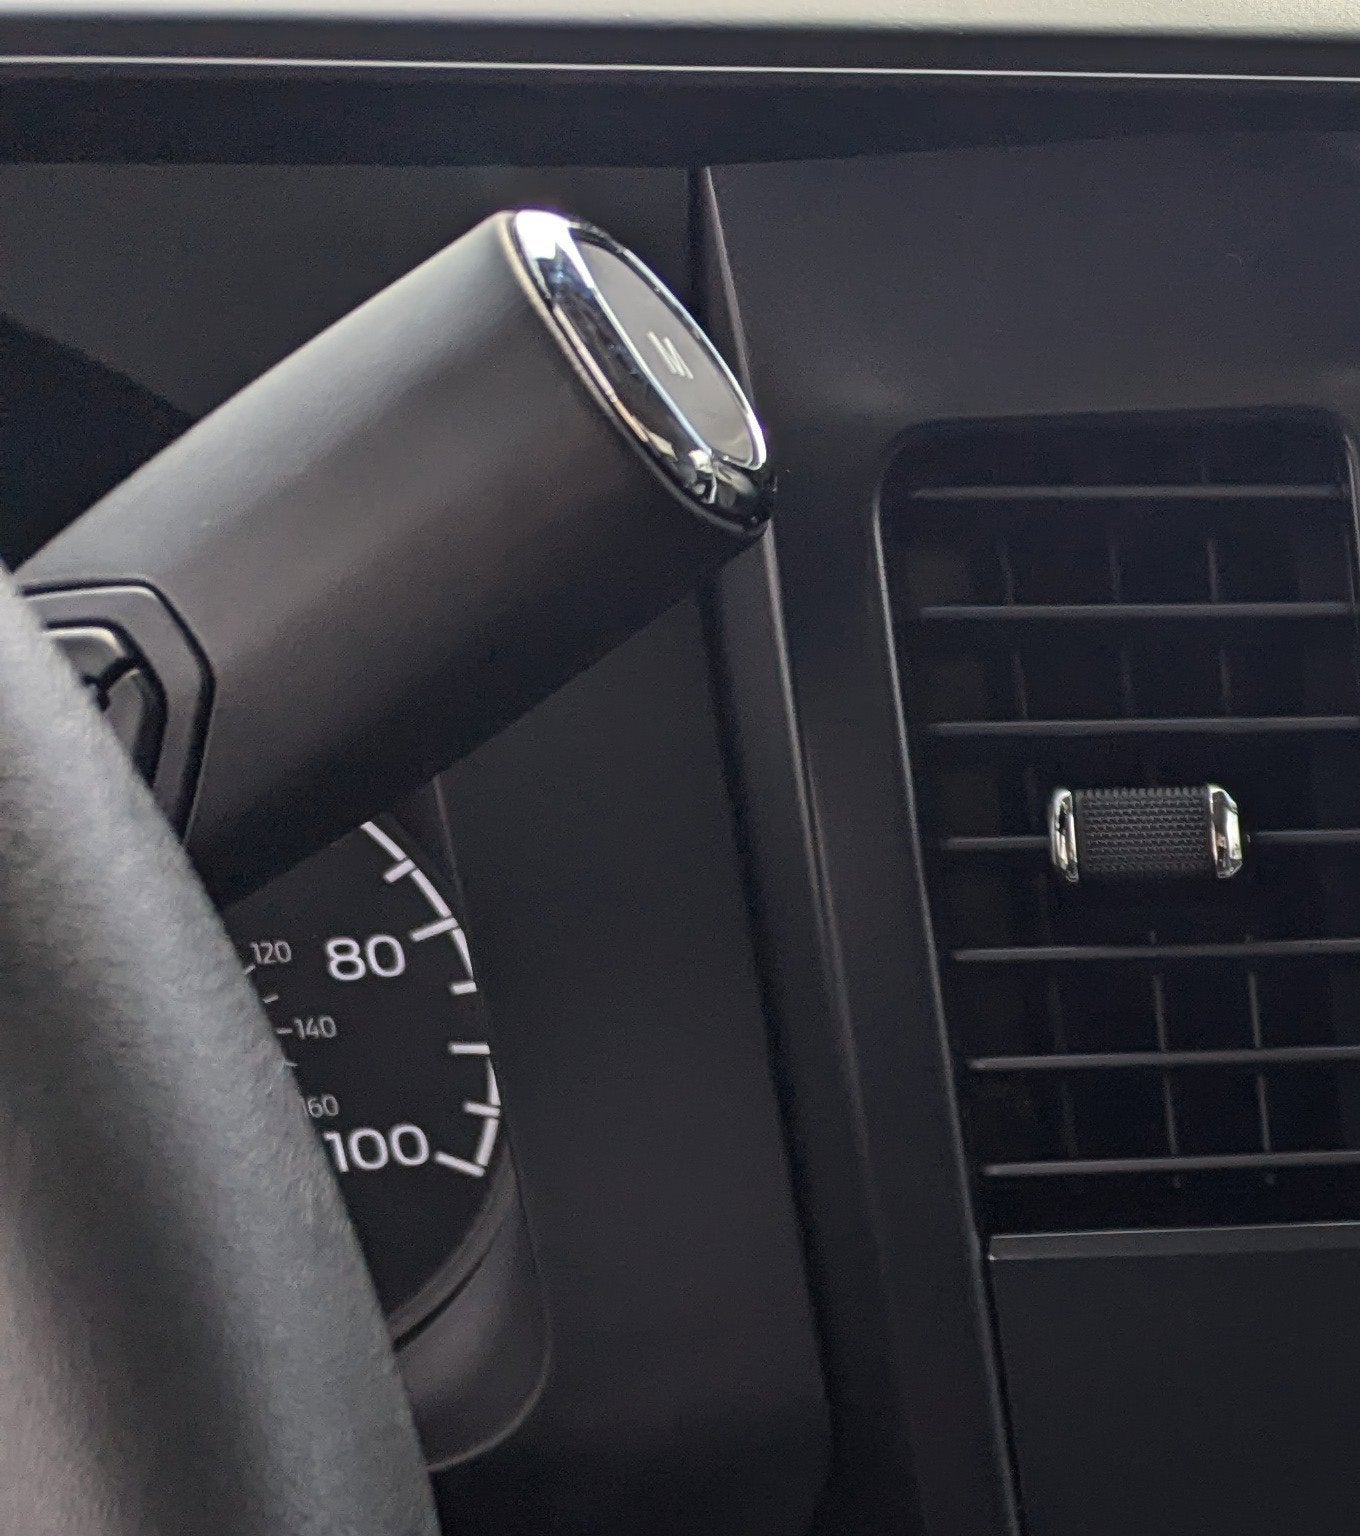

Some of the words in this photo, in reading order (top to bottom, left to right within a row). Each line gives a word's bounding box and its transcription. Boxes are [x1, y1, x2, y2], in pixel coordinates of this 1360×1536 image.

[251, 941, 292, 964] 120
[325, 934, 406, 981] 80
[293, 1015, 337, 1040] 140
[323, 1124, 430, 1172] 100
